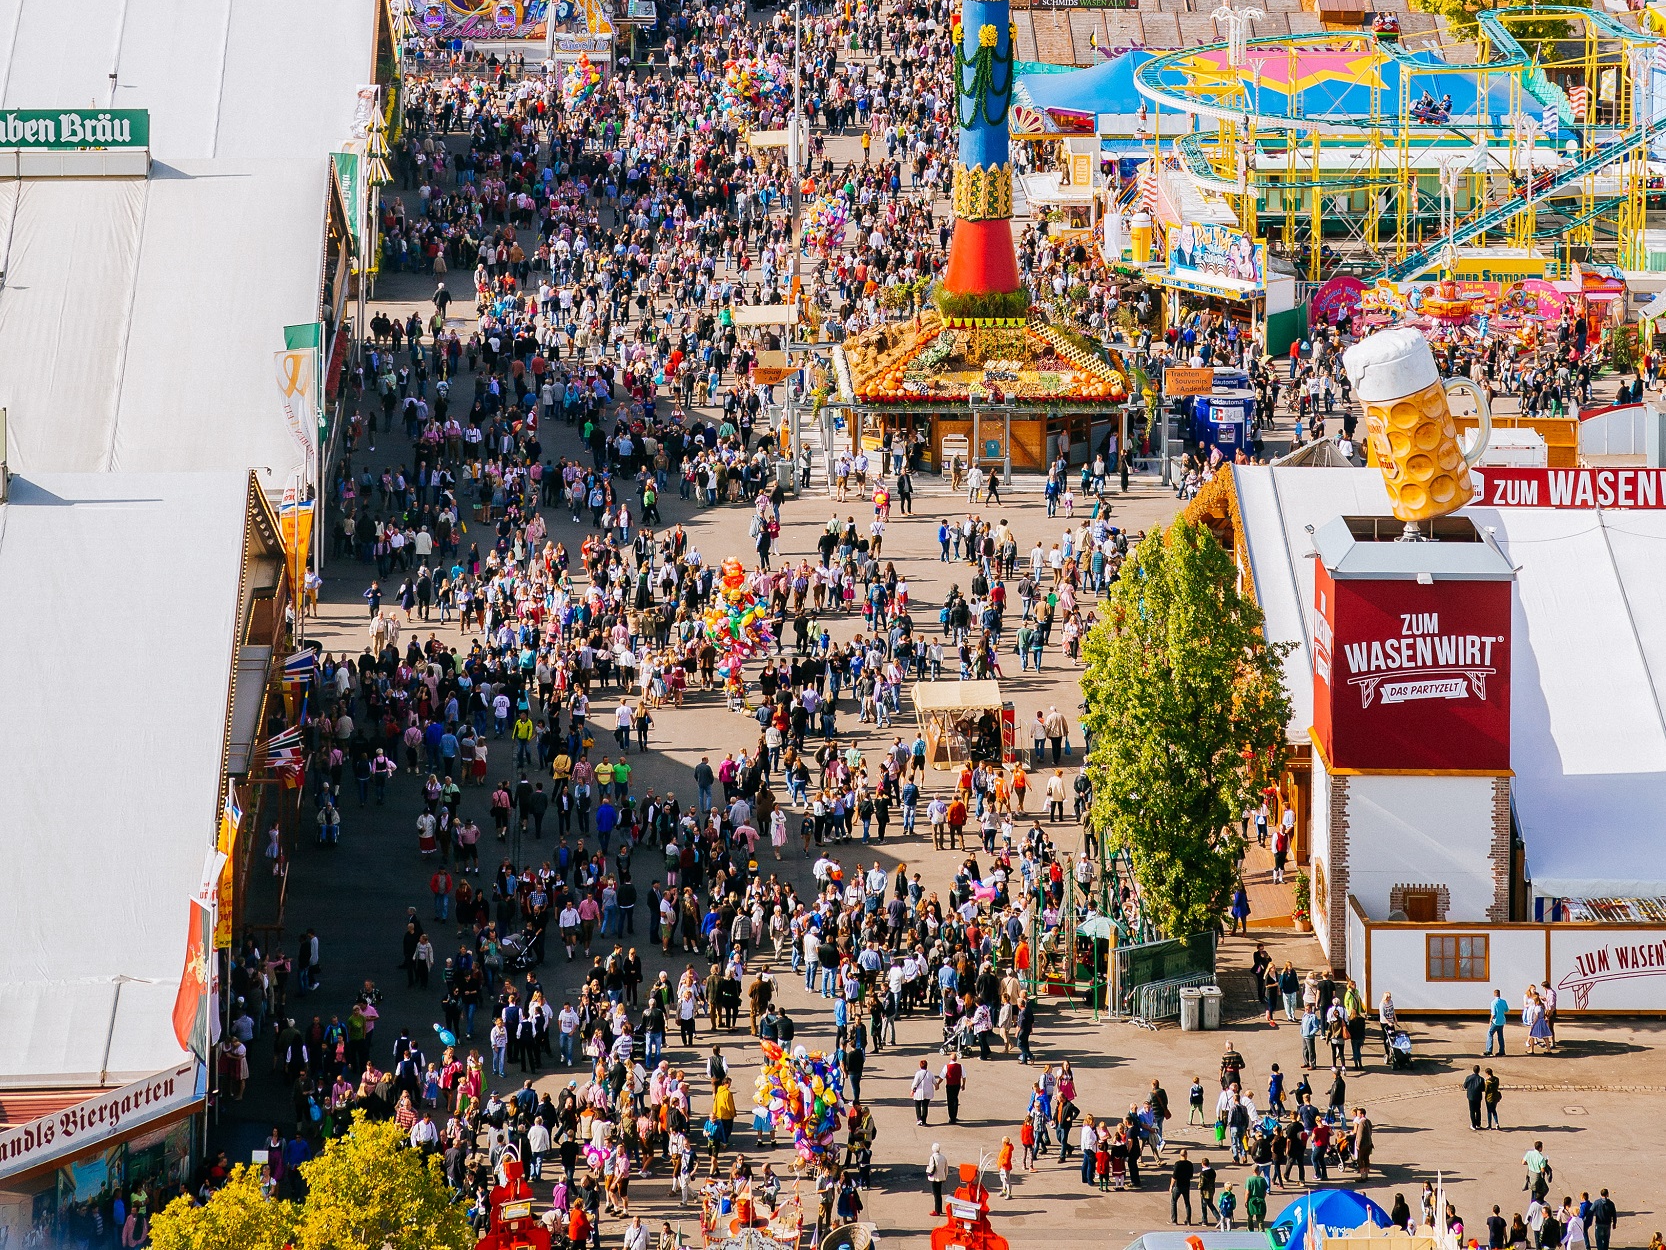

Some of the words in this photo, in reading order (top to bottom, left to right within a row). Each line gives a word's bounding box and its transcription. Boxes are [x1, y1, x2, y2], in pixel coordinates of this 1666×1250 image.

[1108, 0, 1126, 7] ALM
[58, 112, 132, 144] Bräu
[1175, 377, 1207, 385] Souvenirs
[1210, 398, 1244, 406] Geldautomat
[1492, 479, 1538, 505] ZUM
[1547, 470, 1666, 506] WASEN
[1400, 612, 1439, 636] ZUM
[1390, 686, 1408, 697] DAS
[1410, 682, 1460, 696] PARTYZELT
[498, 700, 505, 708] 10
[1575, 949, 1611, 978] ZUM
[60, 1077, 175, 1138] Biergarten
